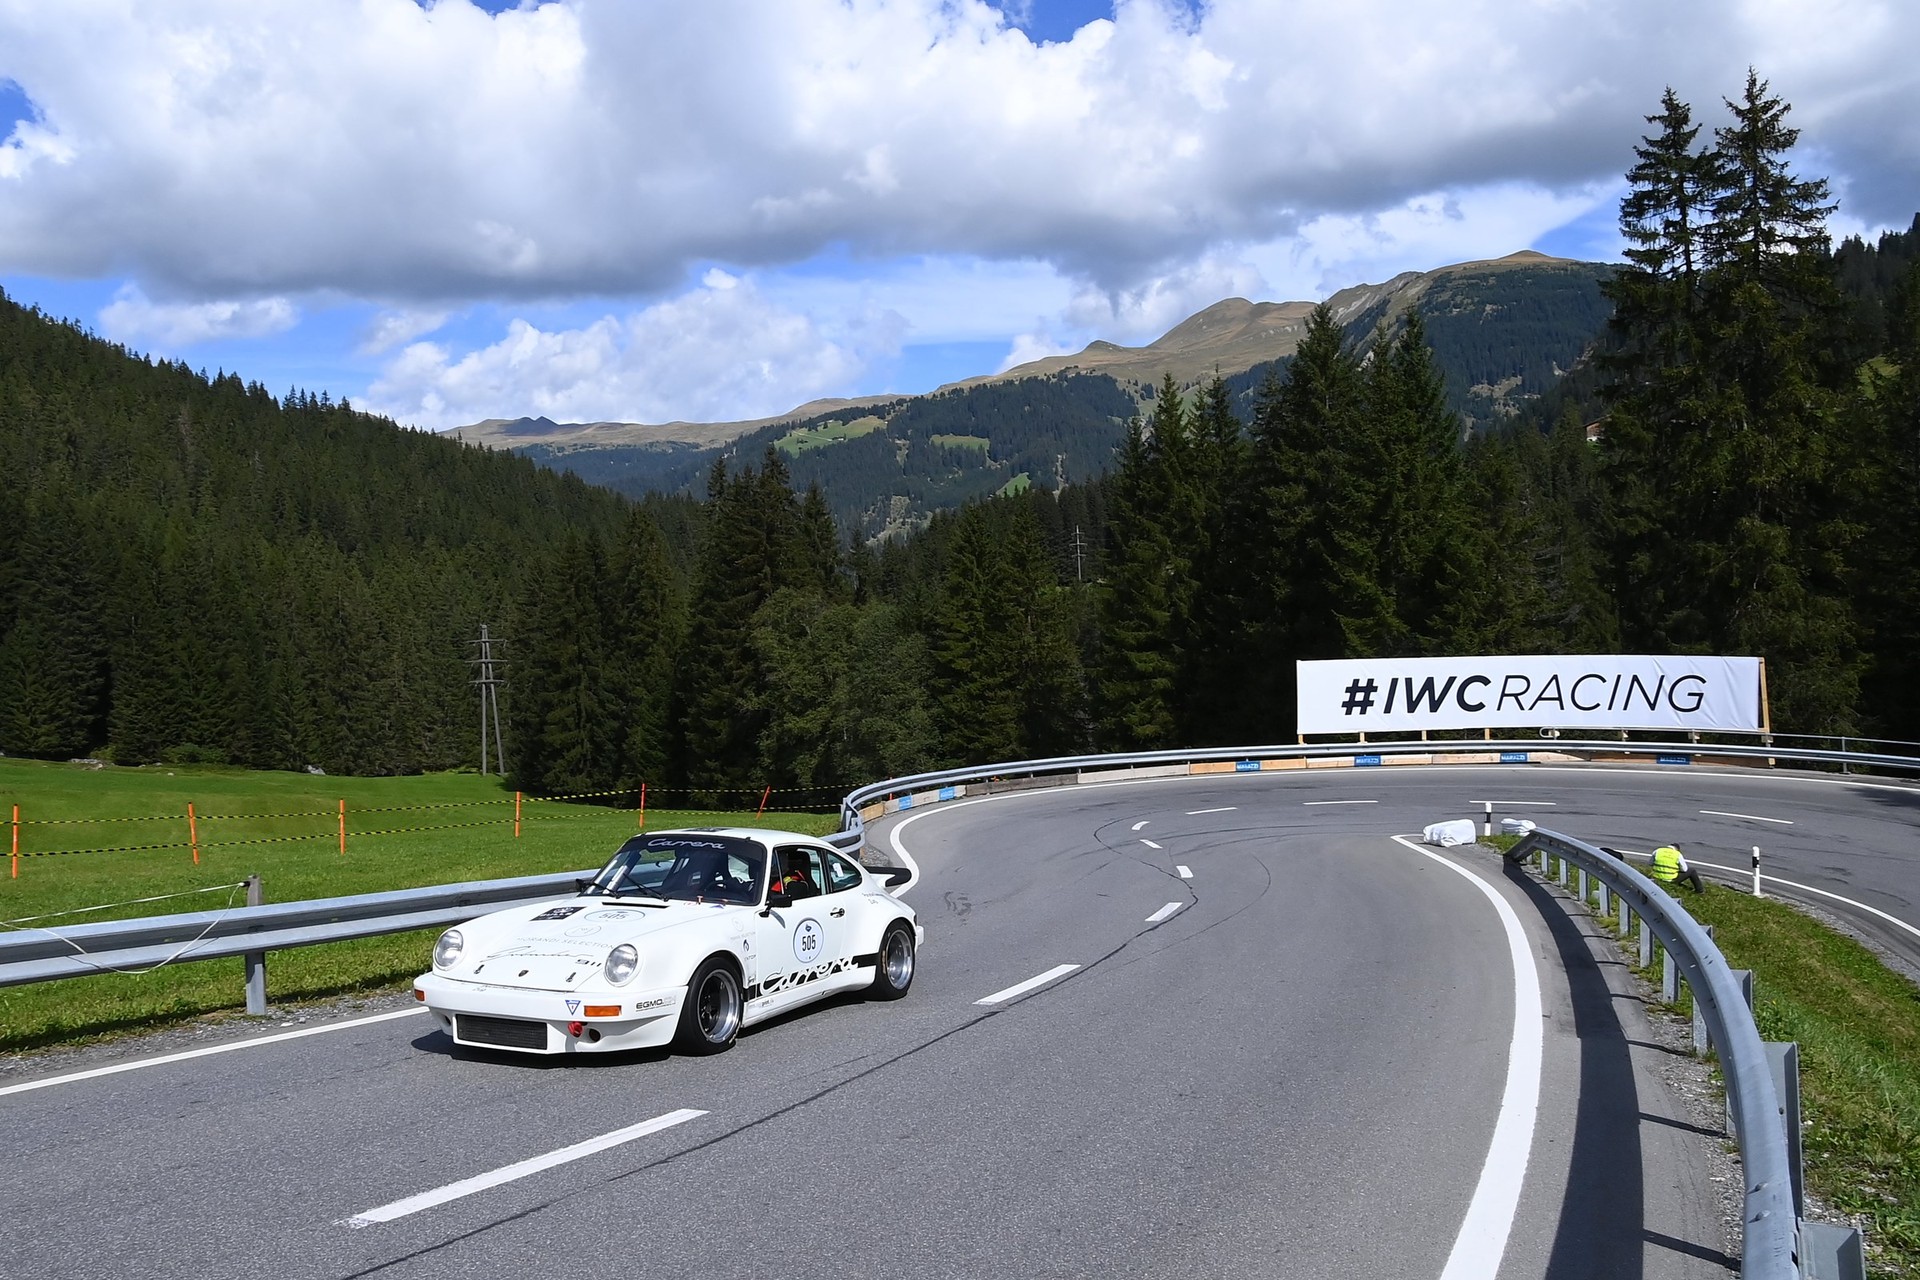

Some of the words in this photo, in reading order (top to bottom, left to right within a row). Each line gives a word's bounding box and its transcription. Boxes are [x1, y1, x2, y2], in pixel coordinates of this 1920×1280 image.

[1341, 674, 1707, 715] #IWCRACING
[647, 838, 726, 849] Carrera
[801, 934, 817, 951] 505
[761, 956, 859, 995] Carrera
